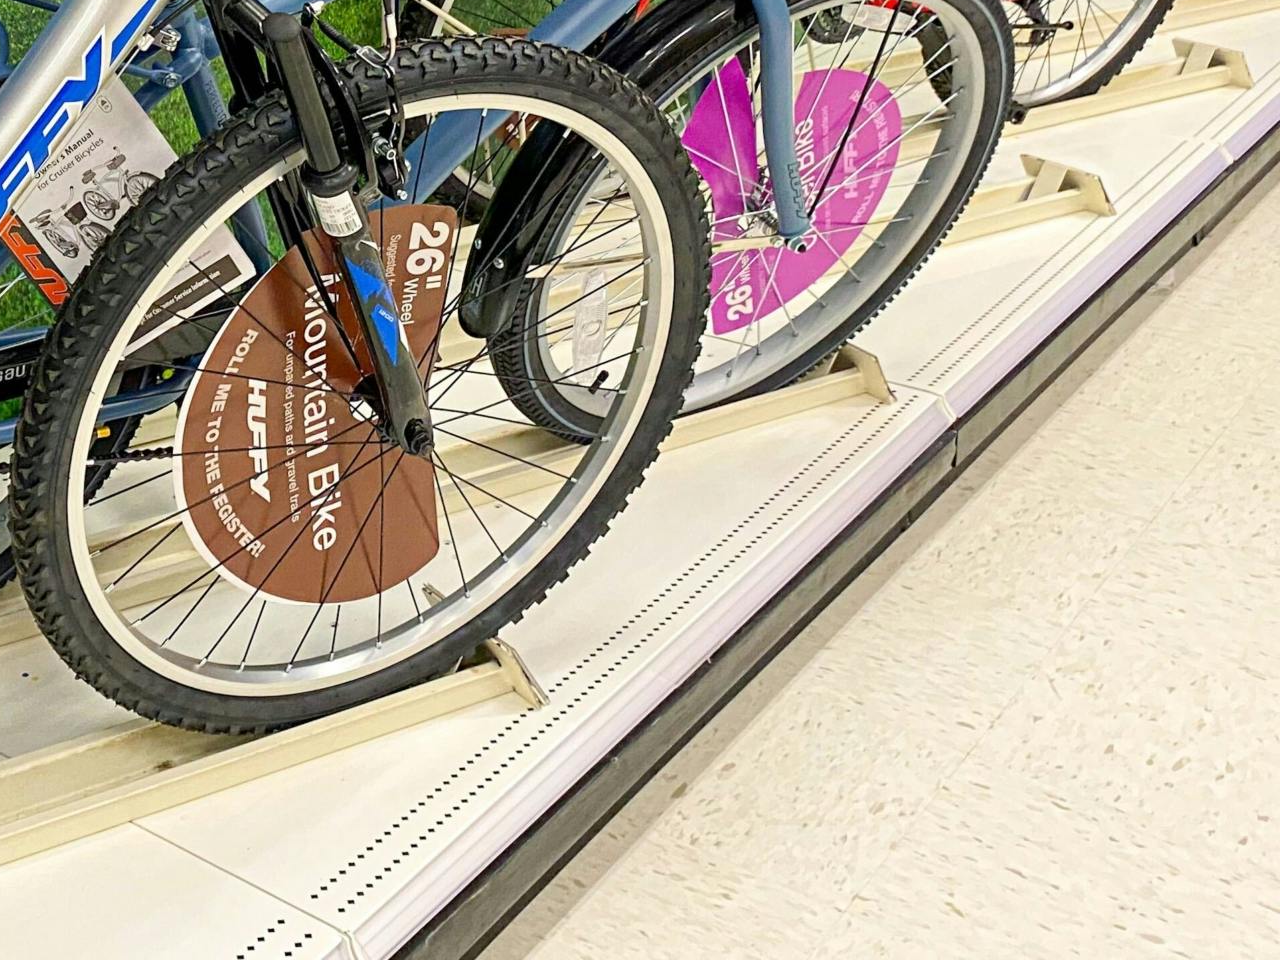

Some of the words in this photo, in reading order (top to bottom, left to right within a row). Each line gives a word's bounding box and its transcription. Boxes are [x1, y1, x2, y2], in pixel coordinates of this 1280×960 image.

[35, 178, 50, 191] for
[46, 157, 76, 183] Cruiser
[72, 135, 106, 164] Bicycles
[62, 127, 95, 156] Manual
[385, 233, 402, 278] Suggested
[405, 221, 450, 290] 26"
[172, 285, 193, 302] Service
[400, 277, 420, 327] Wheel
[223, 328, 260, 379] ROLL
[285, 330, 296, 352] For
[210, 382, 233, 413] ME
[282, 353, 296, 400] unpaved
[205, 415, 222, 444] TO
[282, 401, 296, 433] paths
[246, 378, 271, 504] HUFFY
[204, 446, 222, 485] THE
[284, 457, 297, 500] gravel
[209, 482, 266, 559] REGISTER!
[308, 463, 342, 551] Bike
